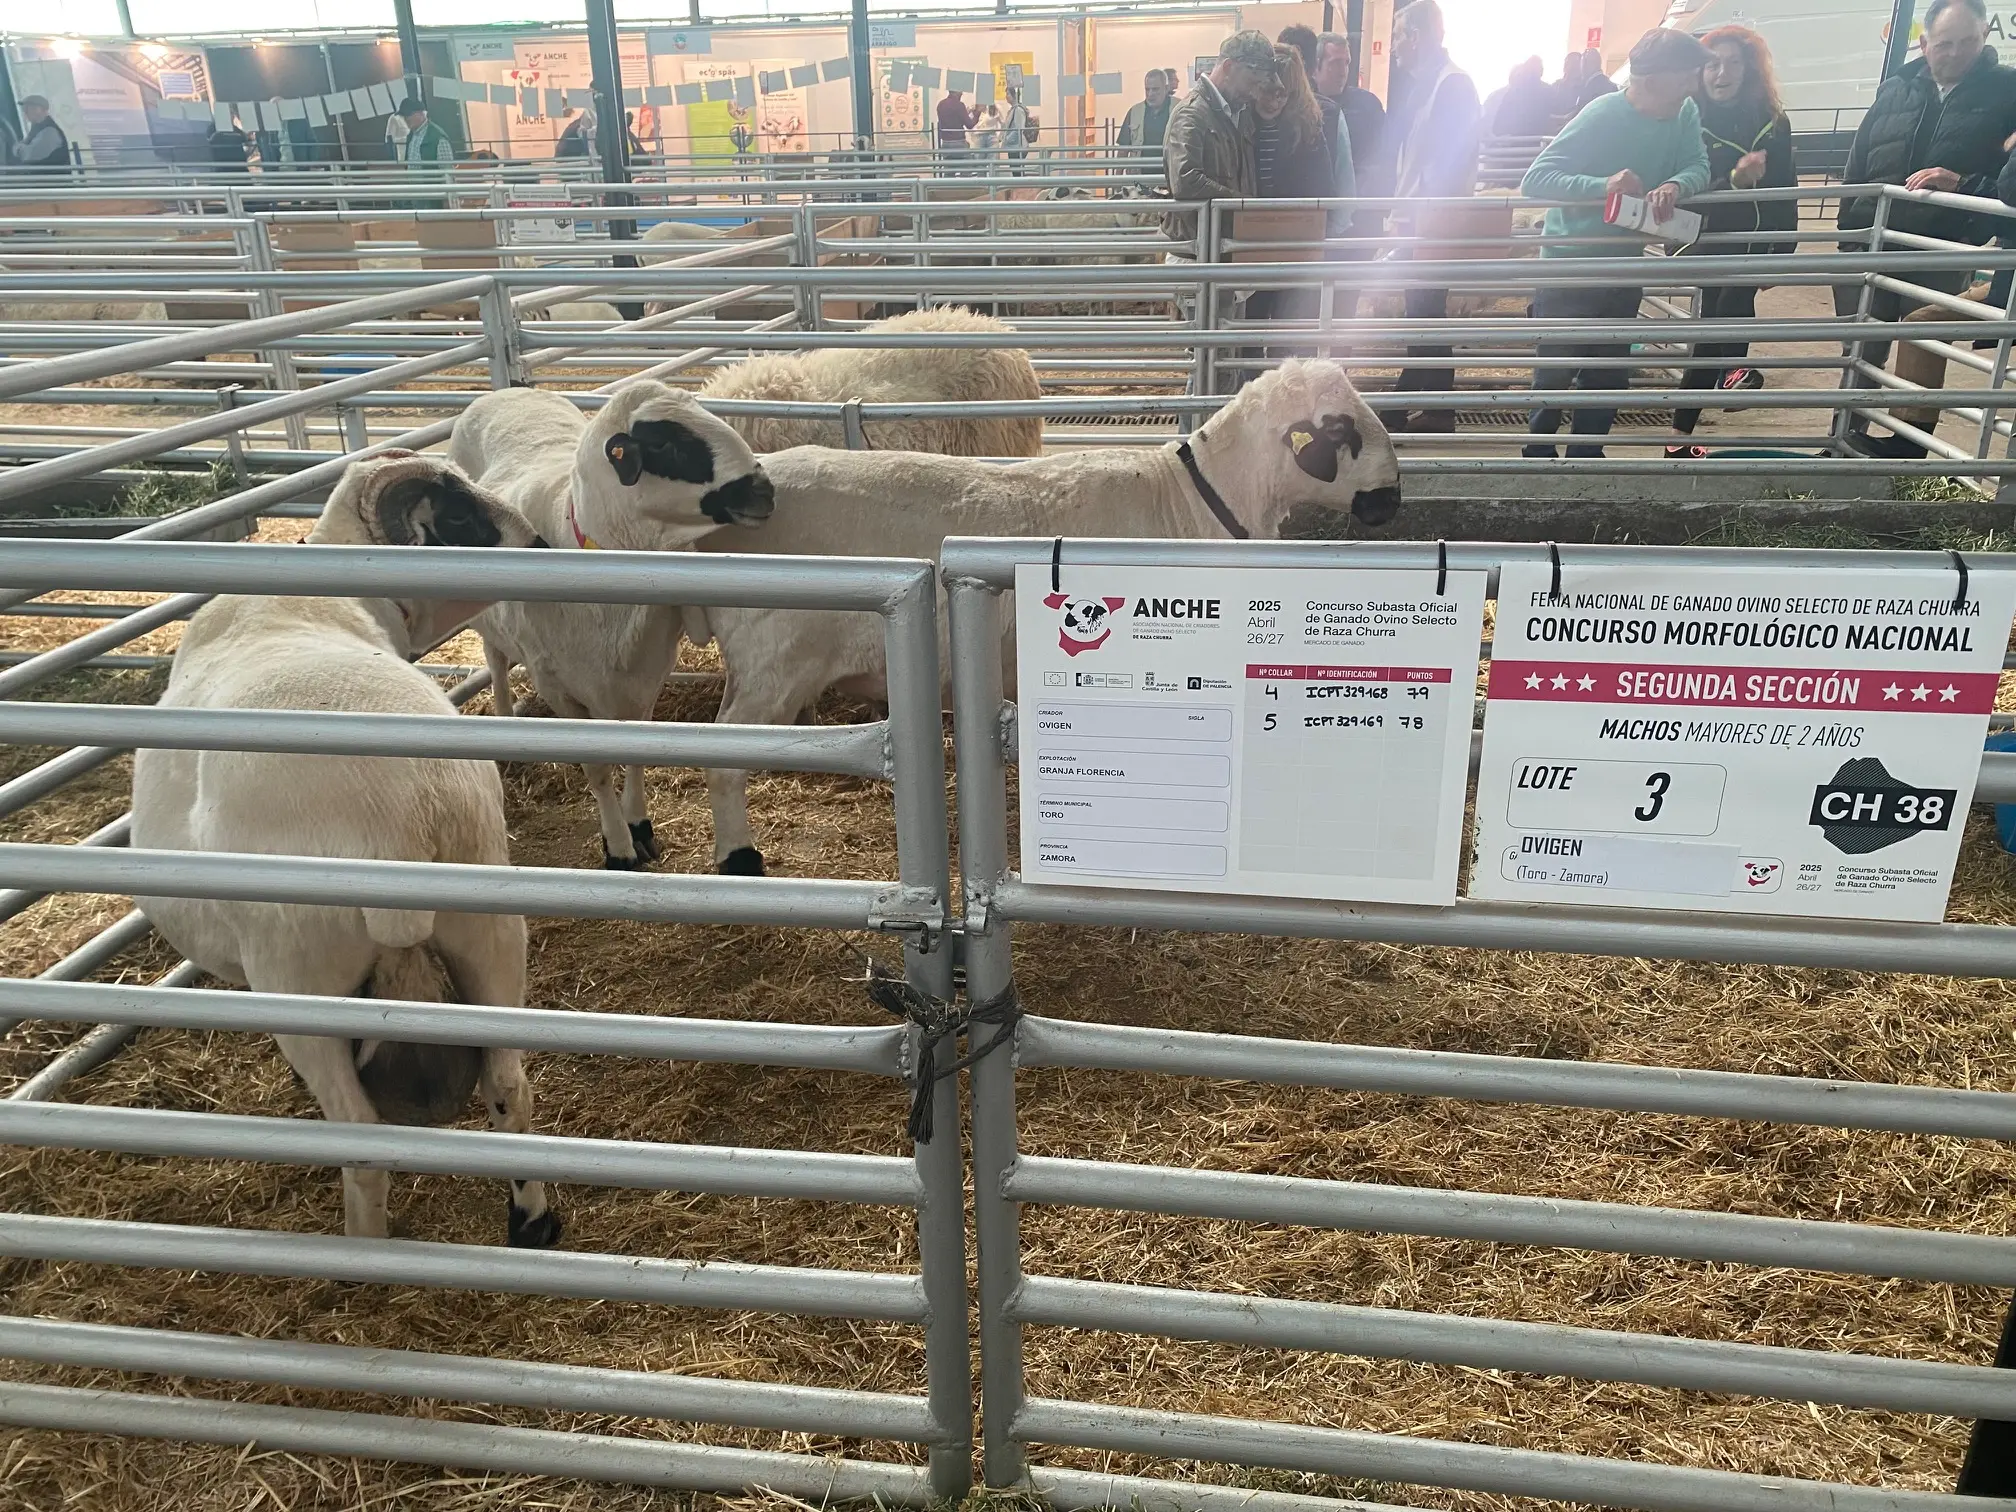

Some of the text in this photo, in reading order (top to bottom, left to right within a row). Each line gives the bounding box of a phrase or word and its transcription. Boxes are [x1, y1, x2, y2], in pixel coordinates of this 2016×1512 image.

[516, 113, 546, 125] ANCHE
[1132, 597, 1221, 619] ANCHE
[1248, 600, 1281, 612] 2025
[1306, 600, 1458, 613] Concurso Subasta Oficial
[1530, 592, 1980, 617] FERIA NACIONAL DE GANADO OVINO SELECTO DE RAZA CHURRA
[1246, 616, 1276, 628] Abril
[1305, 614, 1458, 626] de Ganado Ovino Selecto
[1304, 626, 1396, 637] de Raza Churra
[1526, 617, 1973, 652] CONCURSO MORFOLÓGICO NACIONAL
[1246, 633, 1284, 645] 26/27
[1326, 670, 1377, 678] IDENTIFICACIÓN
[1407, 672, 1433, 680] PUNTOS
[1265, 684, 1278, 700] 4
[1407, 686, 1429, 700] 79
[1616, 670, 1861, 704] SEGUNDA SECCIÓN
[1039, 722, 1072, 730] OVIGEN
[1263, 713, 1277, 731] 5
[1398, 716, 1424, 730] 78
[1599, 718, 1864, 747] MACHOS MAYORES DE 2 AÑOS
[1040, 767, 1125, 777] GRANJA FLORENCIA
[1517, 765, 1671, 822] LOTE 3
[1820, 791, 1944, 824] CH 38
[1521, 836, 1583, 857] OVIGEN
[1040, 854, 1076, 862] ZAMORA
[1516, 865, 1547, 880] (Toro
[1559, 868, 1609, 886] Zamora)
